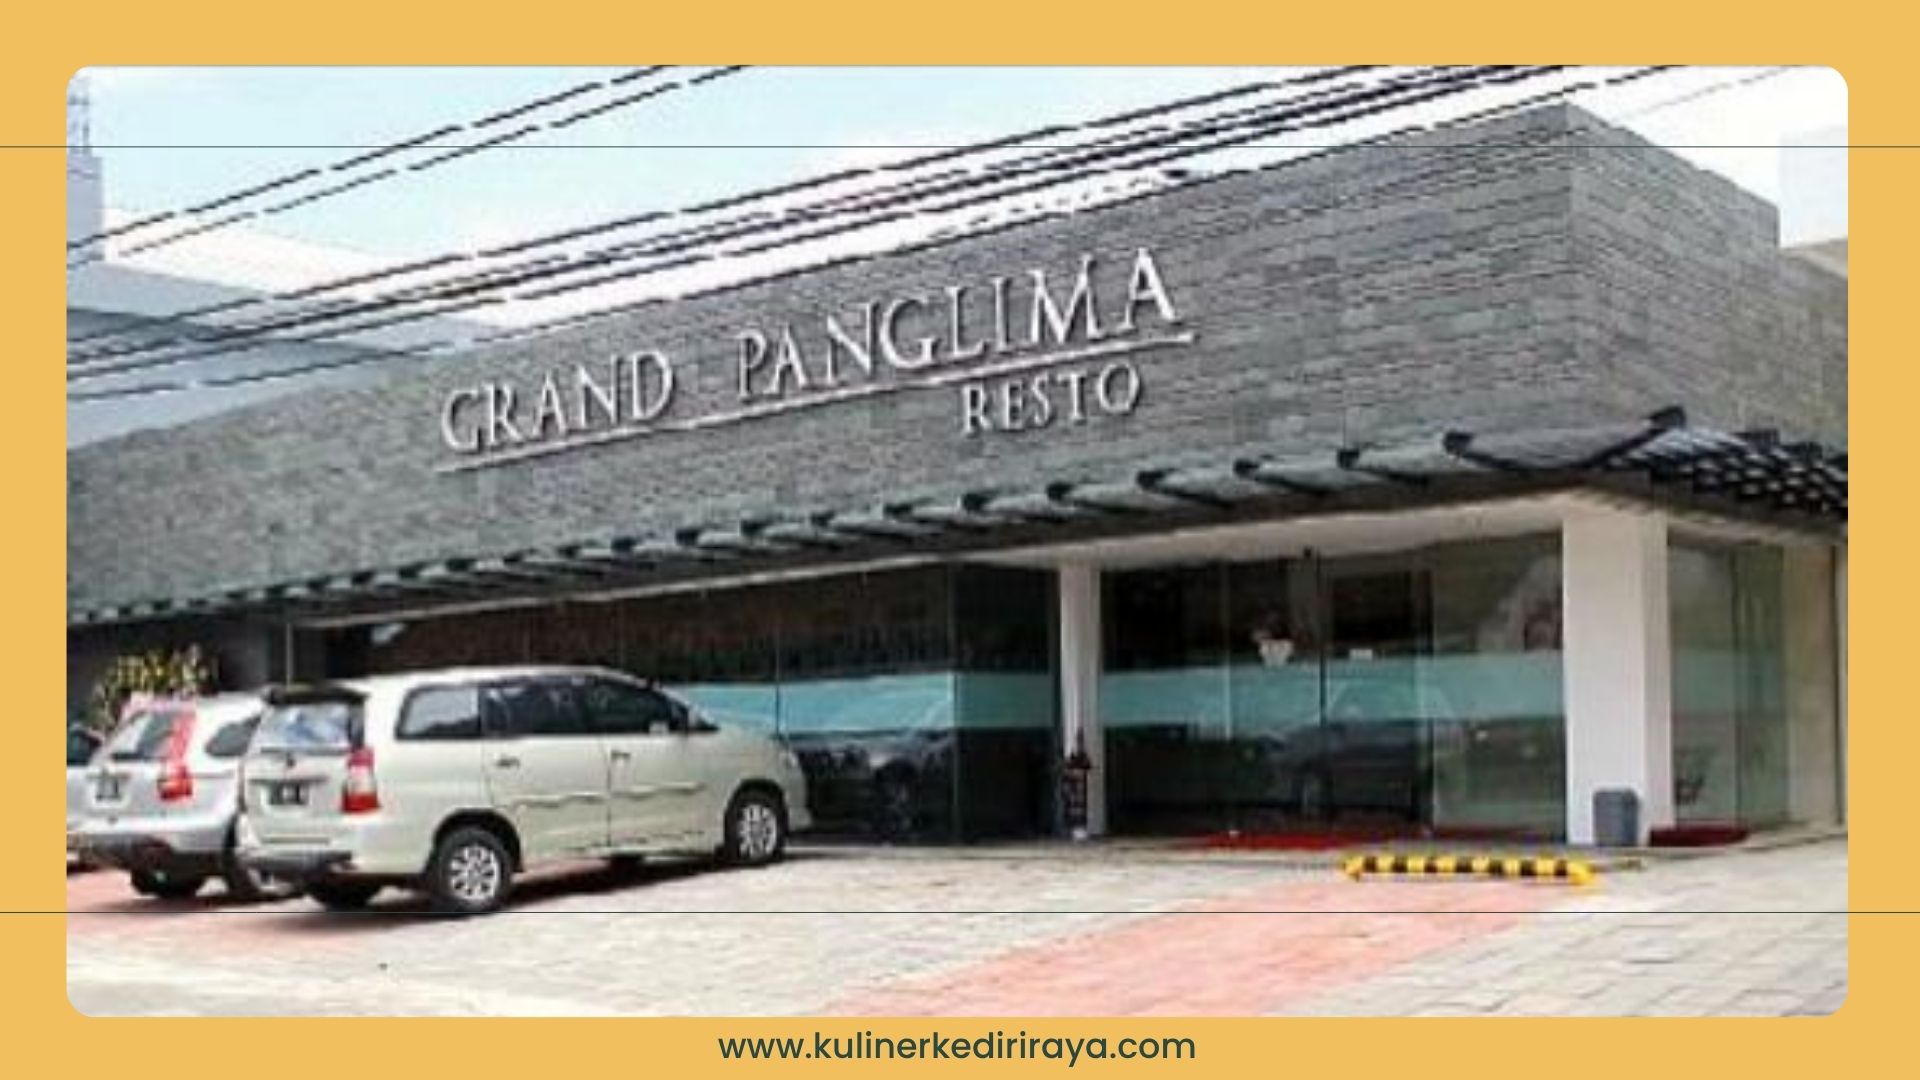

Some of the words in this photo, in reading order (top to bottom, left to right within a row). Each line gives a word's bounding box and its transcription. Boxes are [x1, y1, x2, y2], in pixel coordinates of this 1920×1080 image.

[441, 350, 675, 451] GRAND
[736, 248, 1178, 398] PANGLIMA
[961, 360, 1141, 433] RESTO
